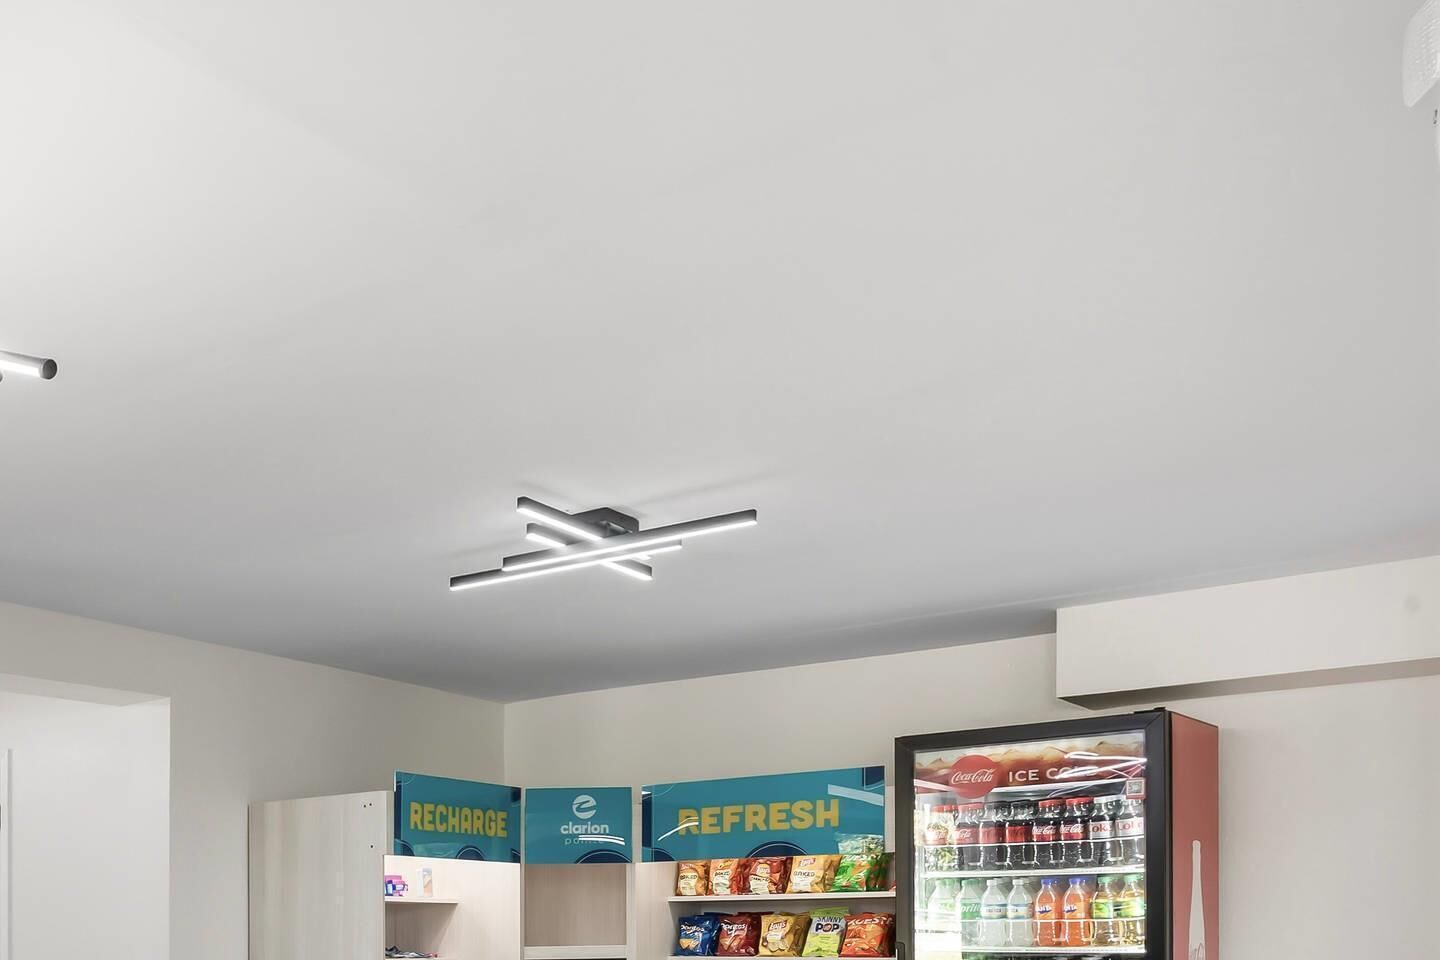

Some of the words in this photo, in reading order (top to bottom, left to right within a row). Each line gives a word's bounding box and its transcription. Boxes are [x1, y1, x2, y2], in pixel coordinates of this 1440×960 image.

[951, 768, 997, 785] Coca-Cola
[1008, 769, 1040, 783] ICE
[409, 801, 508, 838] RECHARGE
[677, 799, 840, 837] REFRESH
[560, 821, 609, 834] clarion
[815, 922, 840, 932] POP
